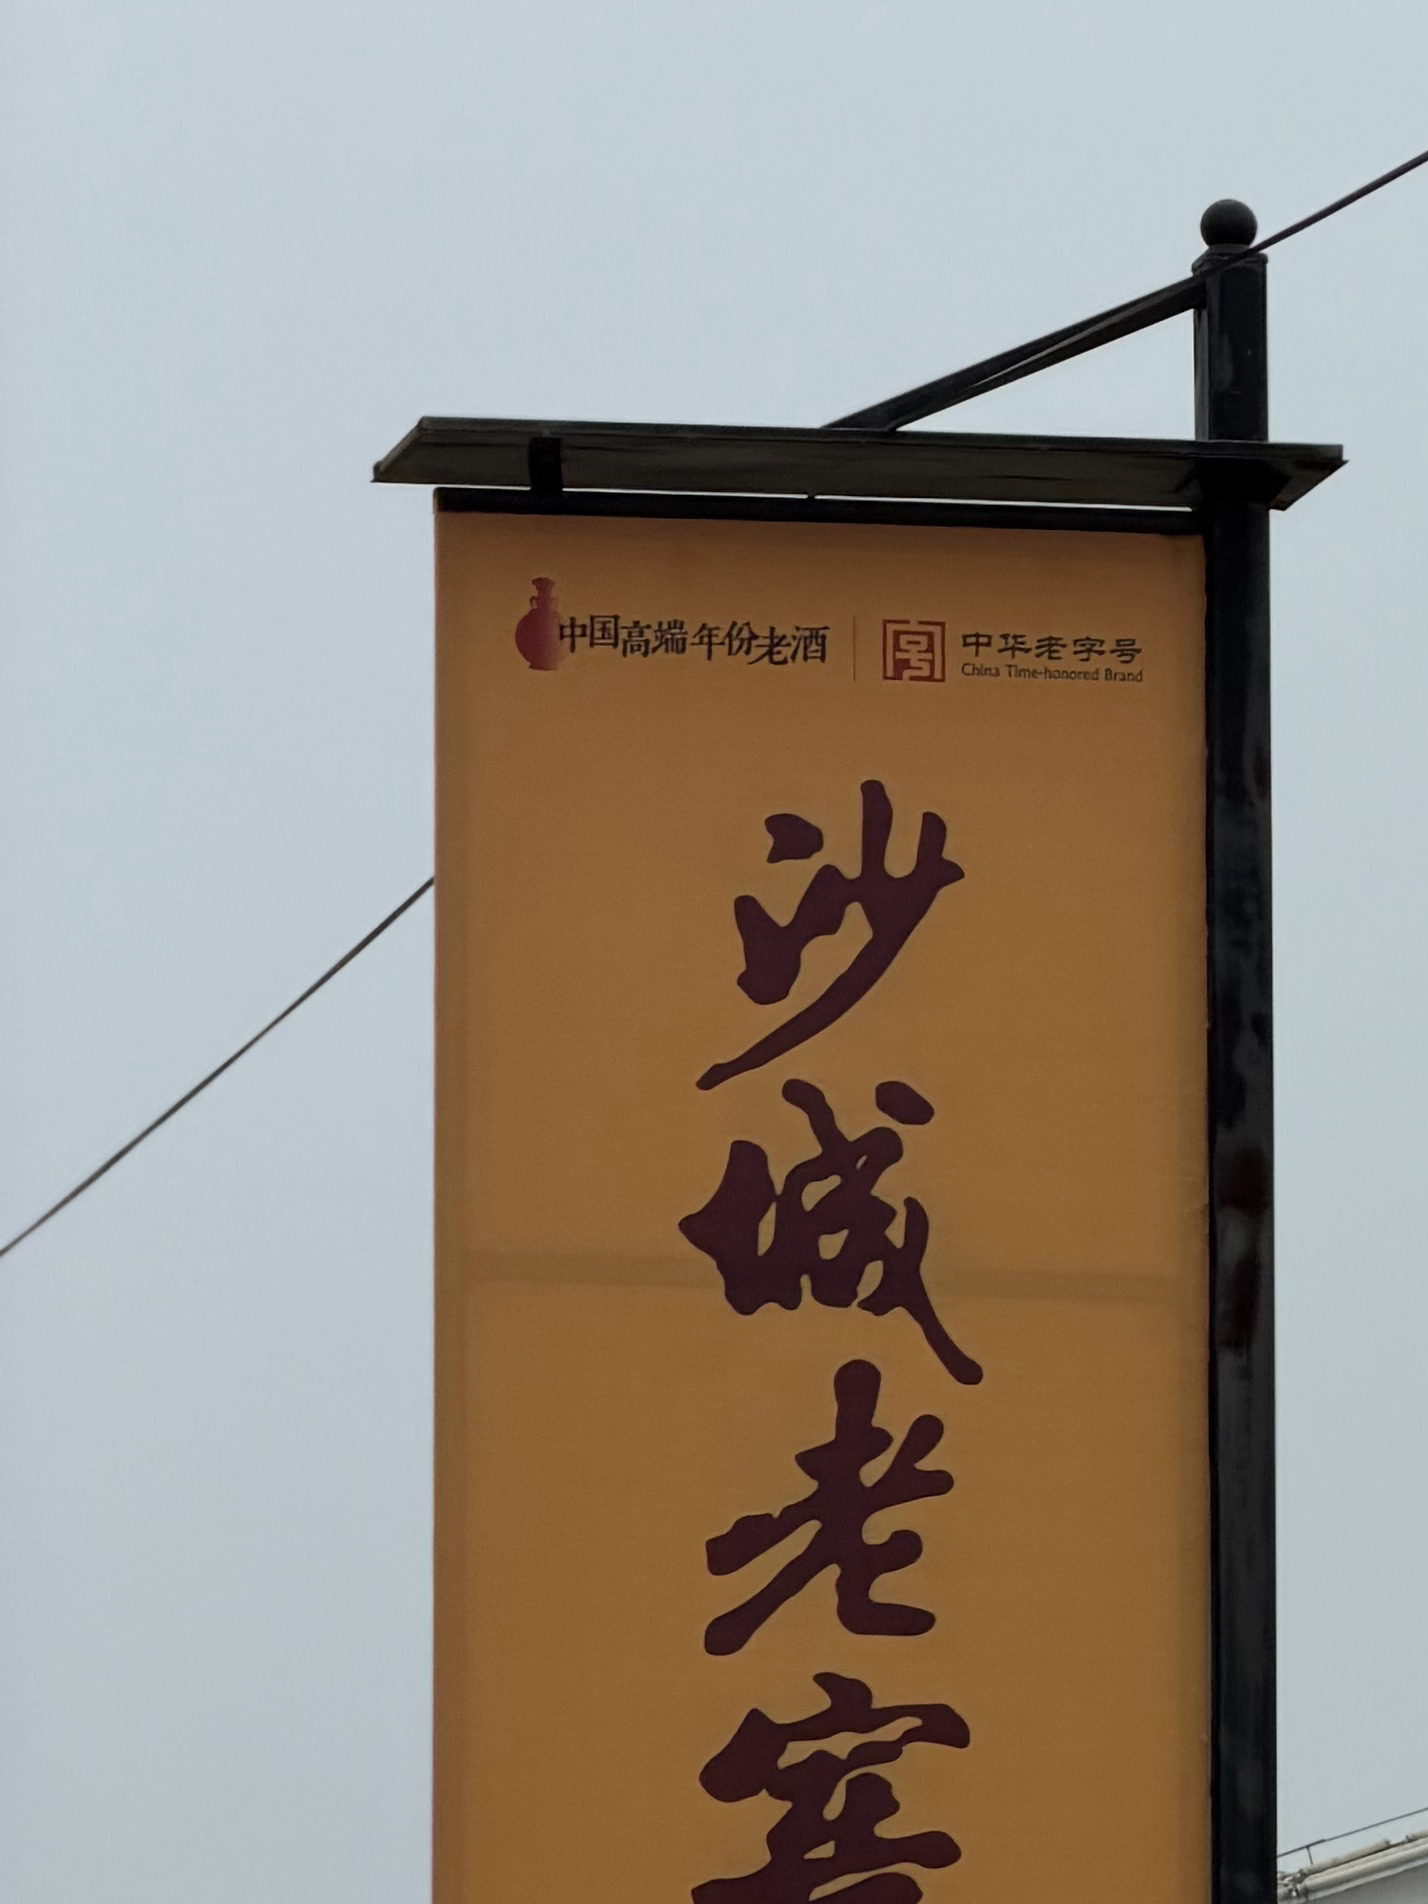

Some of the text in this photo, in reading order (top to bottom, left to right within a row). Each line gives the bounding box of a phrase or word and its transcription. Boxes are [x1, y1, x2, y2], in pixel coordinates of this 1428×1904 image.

[559, 614, 830, 666] 中国高端年份老酒
[961, 632, 1142, 665] 中华老字号
[961, 662, 1144, 684] China Time-honored Brand
